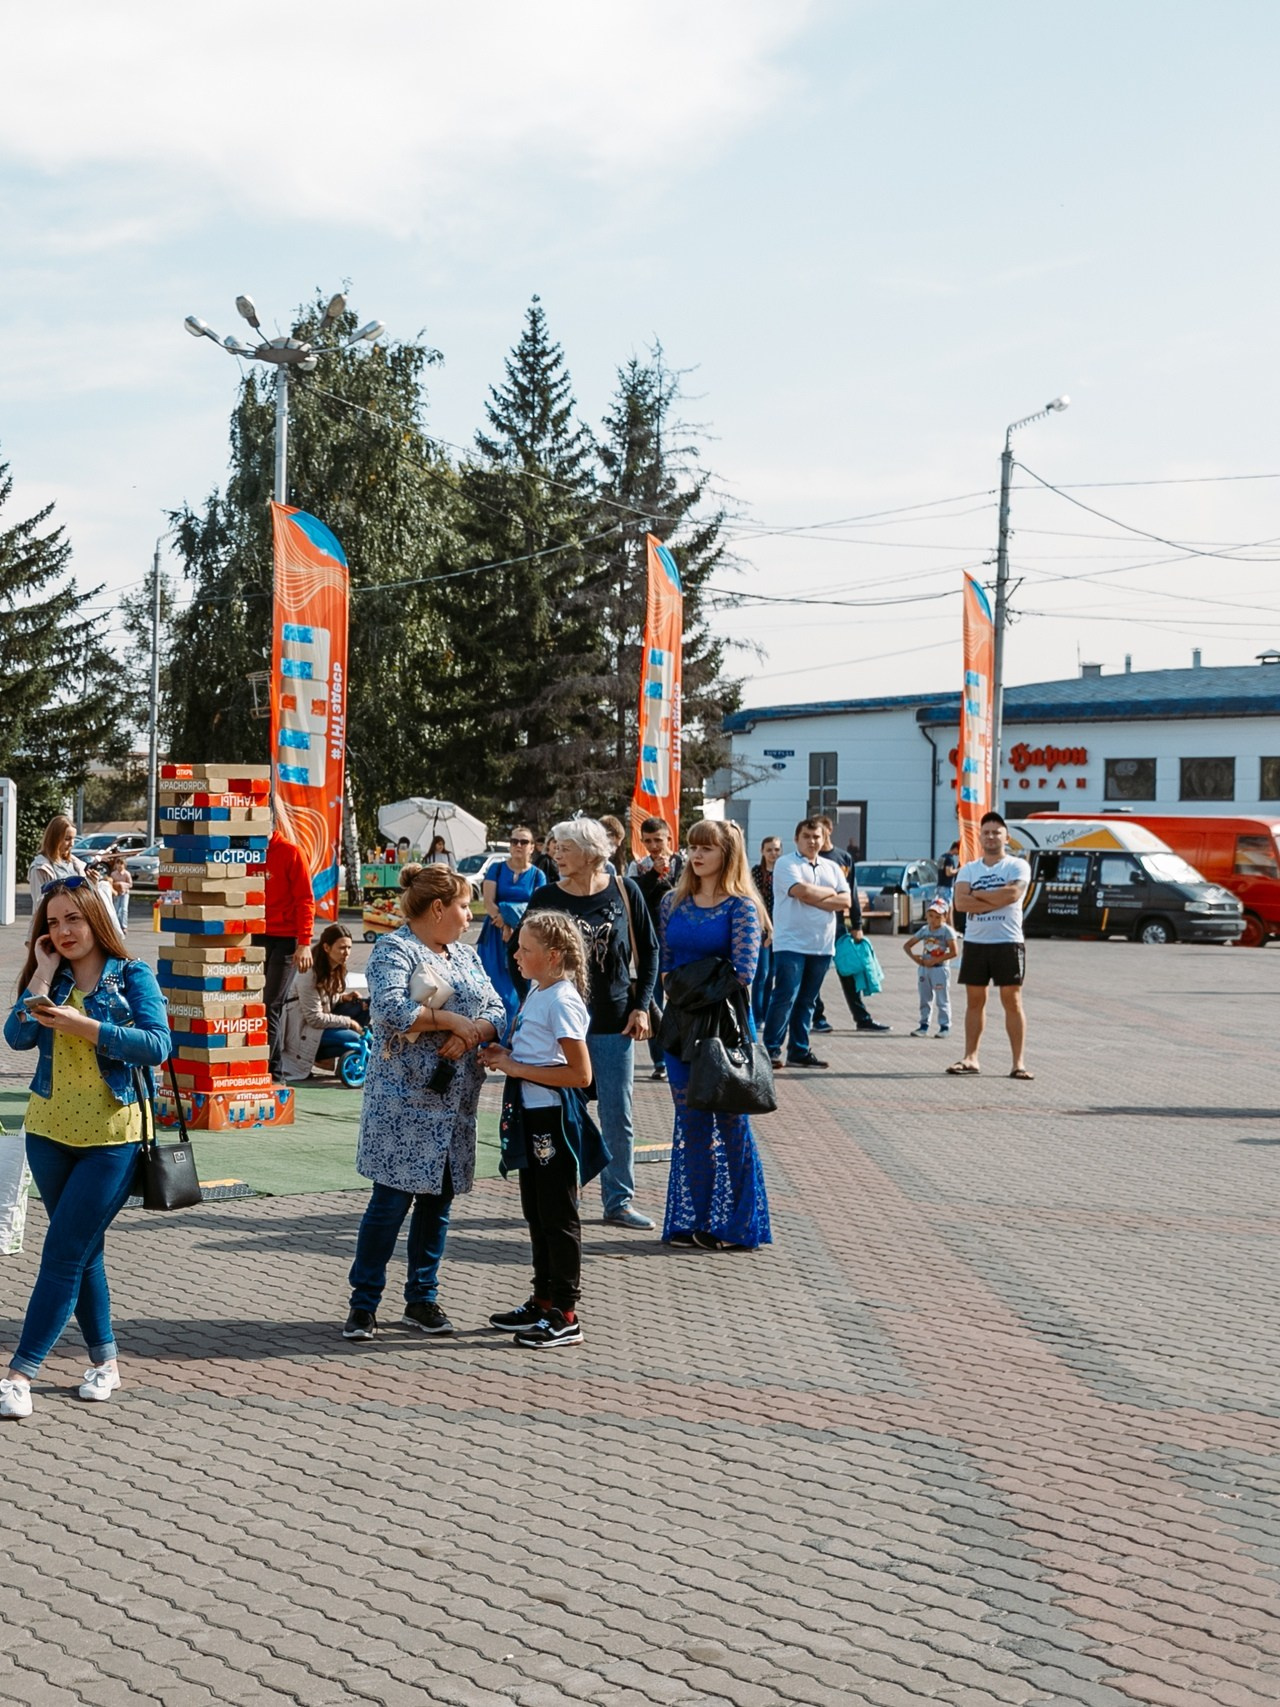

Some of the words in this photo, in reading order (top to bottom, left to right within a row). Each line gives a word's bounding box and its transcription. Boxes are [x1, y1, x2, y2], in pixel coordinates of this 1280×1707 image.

[160, 781, 207, 790] КРАСНОЯРСК
[951, 778, 1087, 789] РТОРАН
[221, 795, 257, 806] ТАНЦЫ
[167, 808, 202, 819] ПЕСНИ
[213, 850, 261, 863] ОСТРОВ
[179, 866, 206, 875] НИЖНИЙ
[207, 964, 261, 975] ХАБАРОВСК
[203, 991, 260, 1002] ВЛАДИВОСТОК
[167, 1004, 203, 1017] ЧЕЛЯБИН
[213, 1019, 263, 1033] УНИВЕР
[213, 1076, 270, 1088] ИМПРОВИЗАЦИЯ
[228, 1098, 276, 1122] ТНТ
